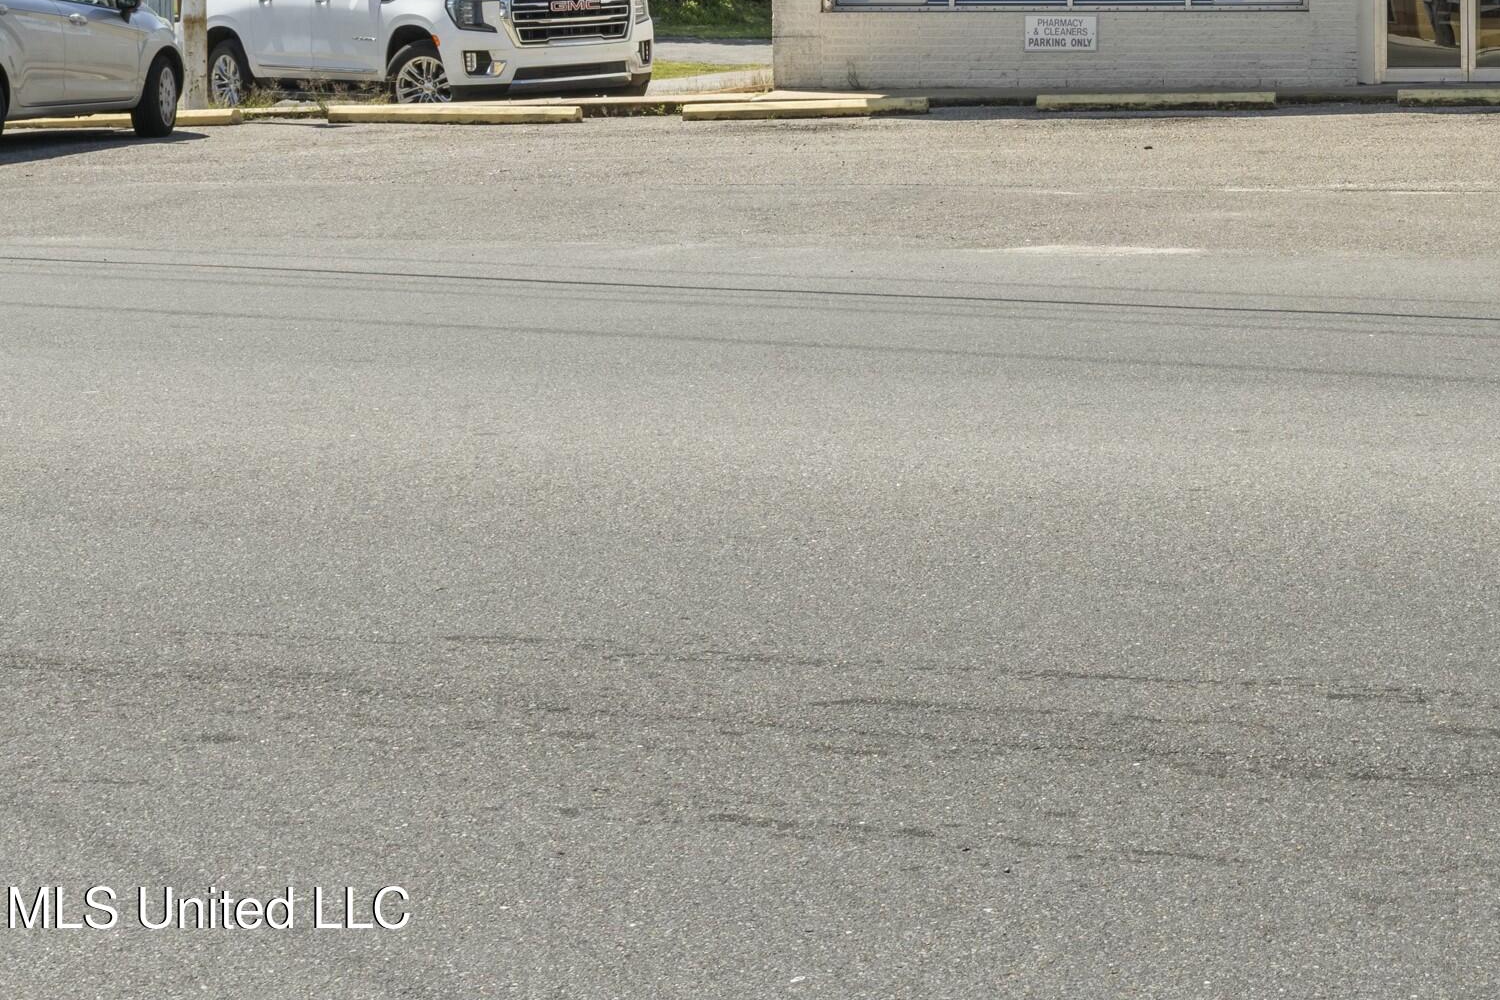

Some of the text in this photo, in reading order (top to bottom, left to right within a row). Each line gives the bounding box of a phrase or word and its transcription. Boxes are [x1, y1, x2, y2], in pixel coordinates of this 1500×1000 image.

[550, 0, 601, 12] GMC
[1038, 18, 1084, 27] PHARMACY
[1033, 28, 1088, 36] & CLEANERS
[1028, 38, 1092, 47] PARKING ONLY
